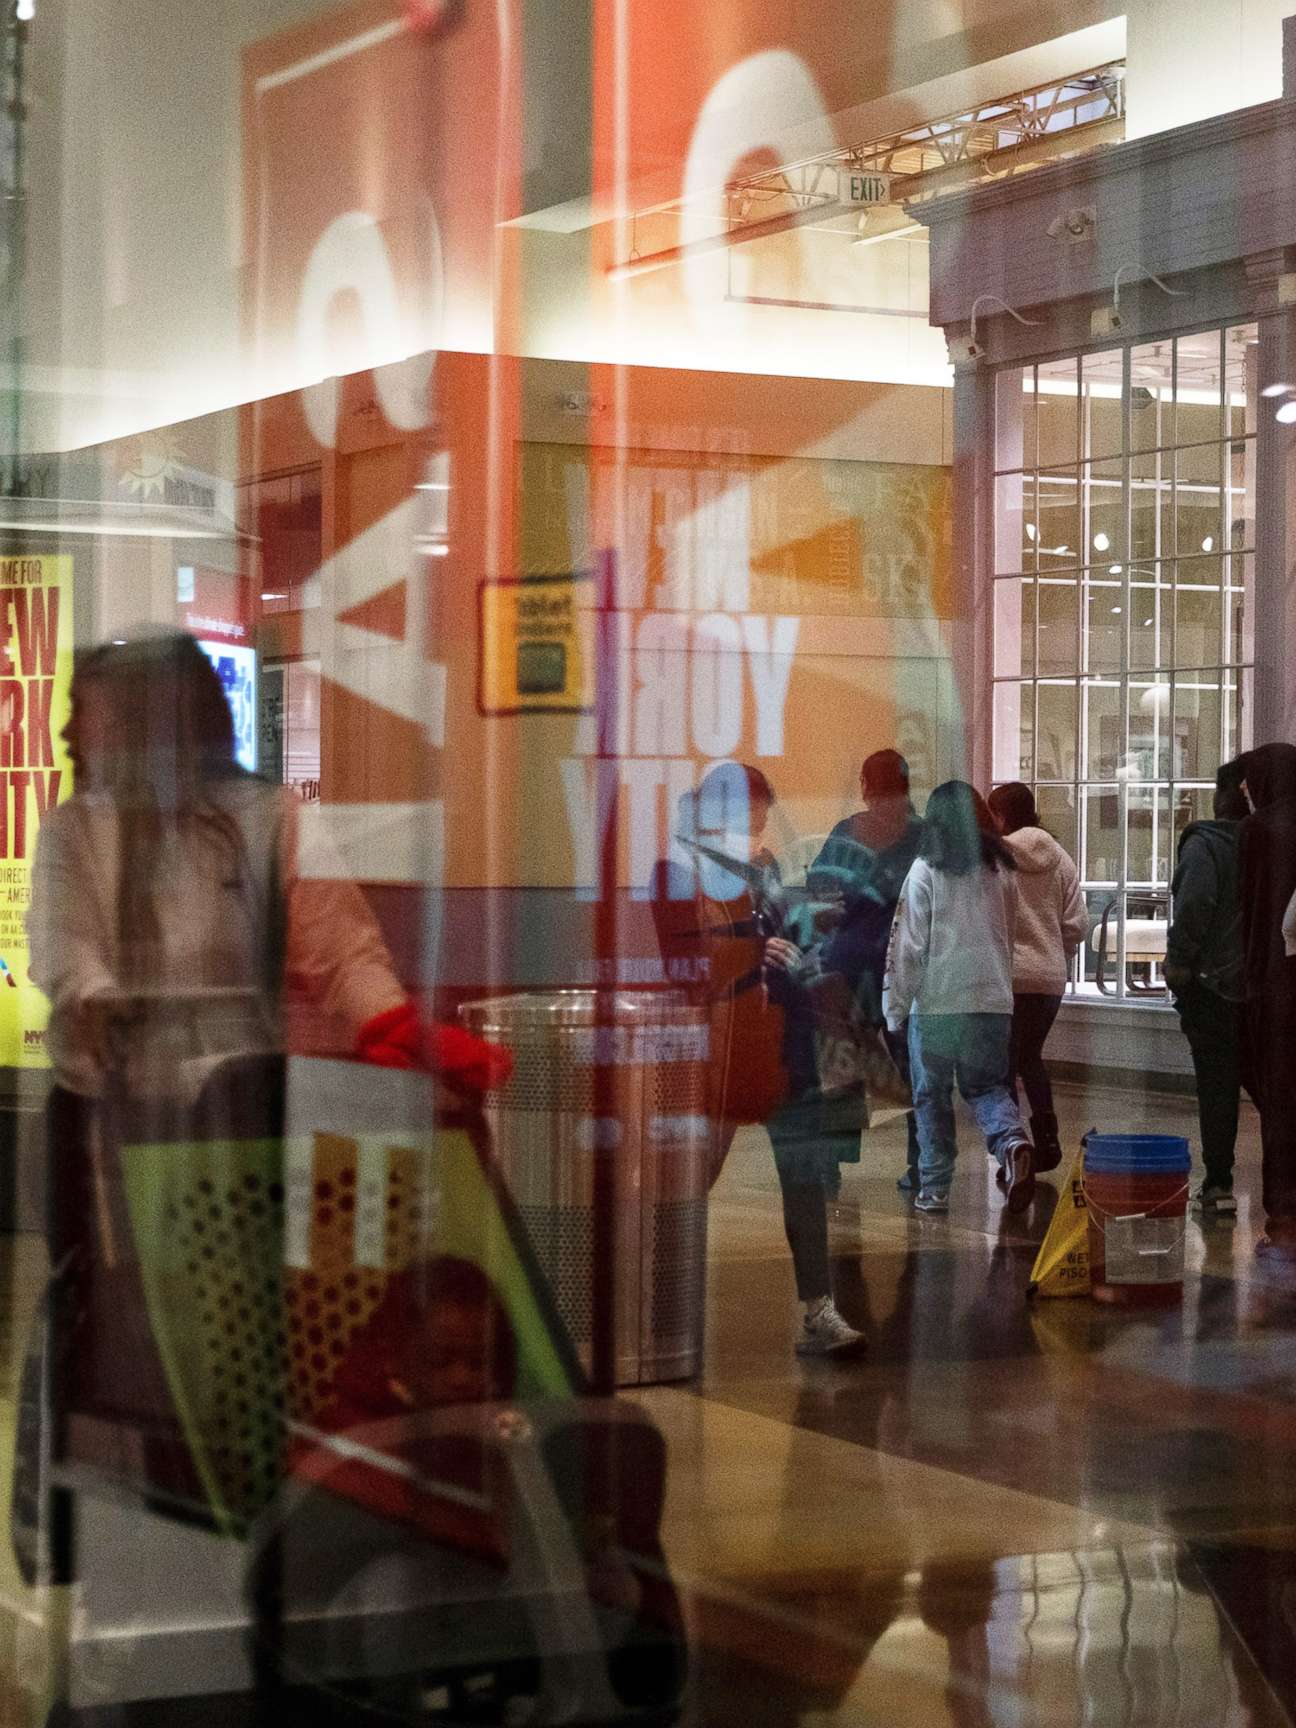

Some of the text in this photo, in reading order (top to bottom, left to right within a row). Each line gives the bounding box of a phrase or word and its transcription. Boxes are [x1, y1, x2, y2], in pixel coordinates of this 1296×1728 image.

[850, 176, 881, 202] EXIT
[21, 559, 41, 585] FOR
[0, 680, 54, 767] RK
